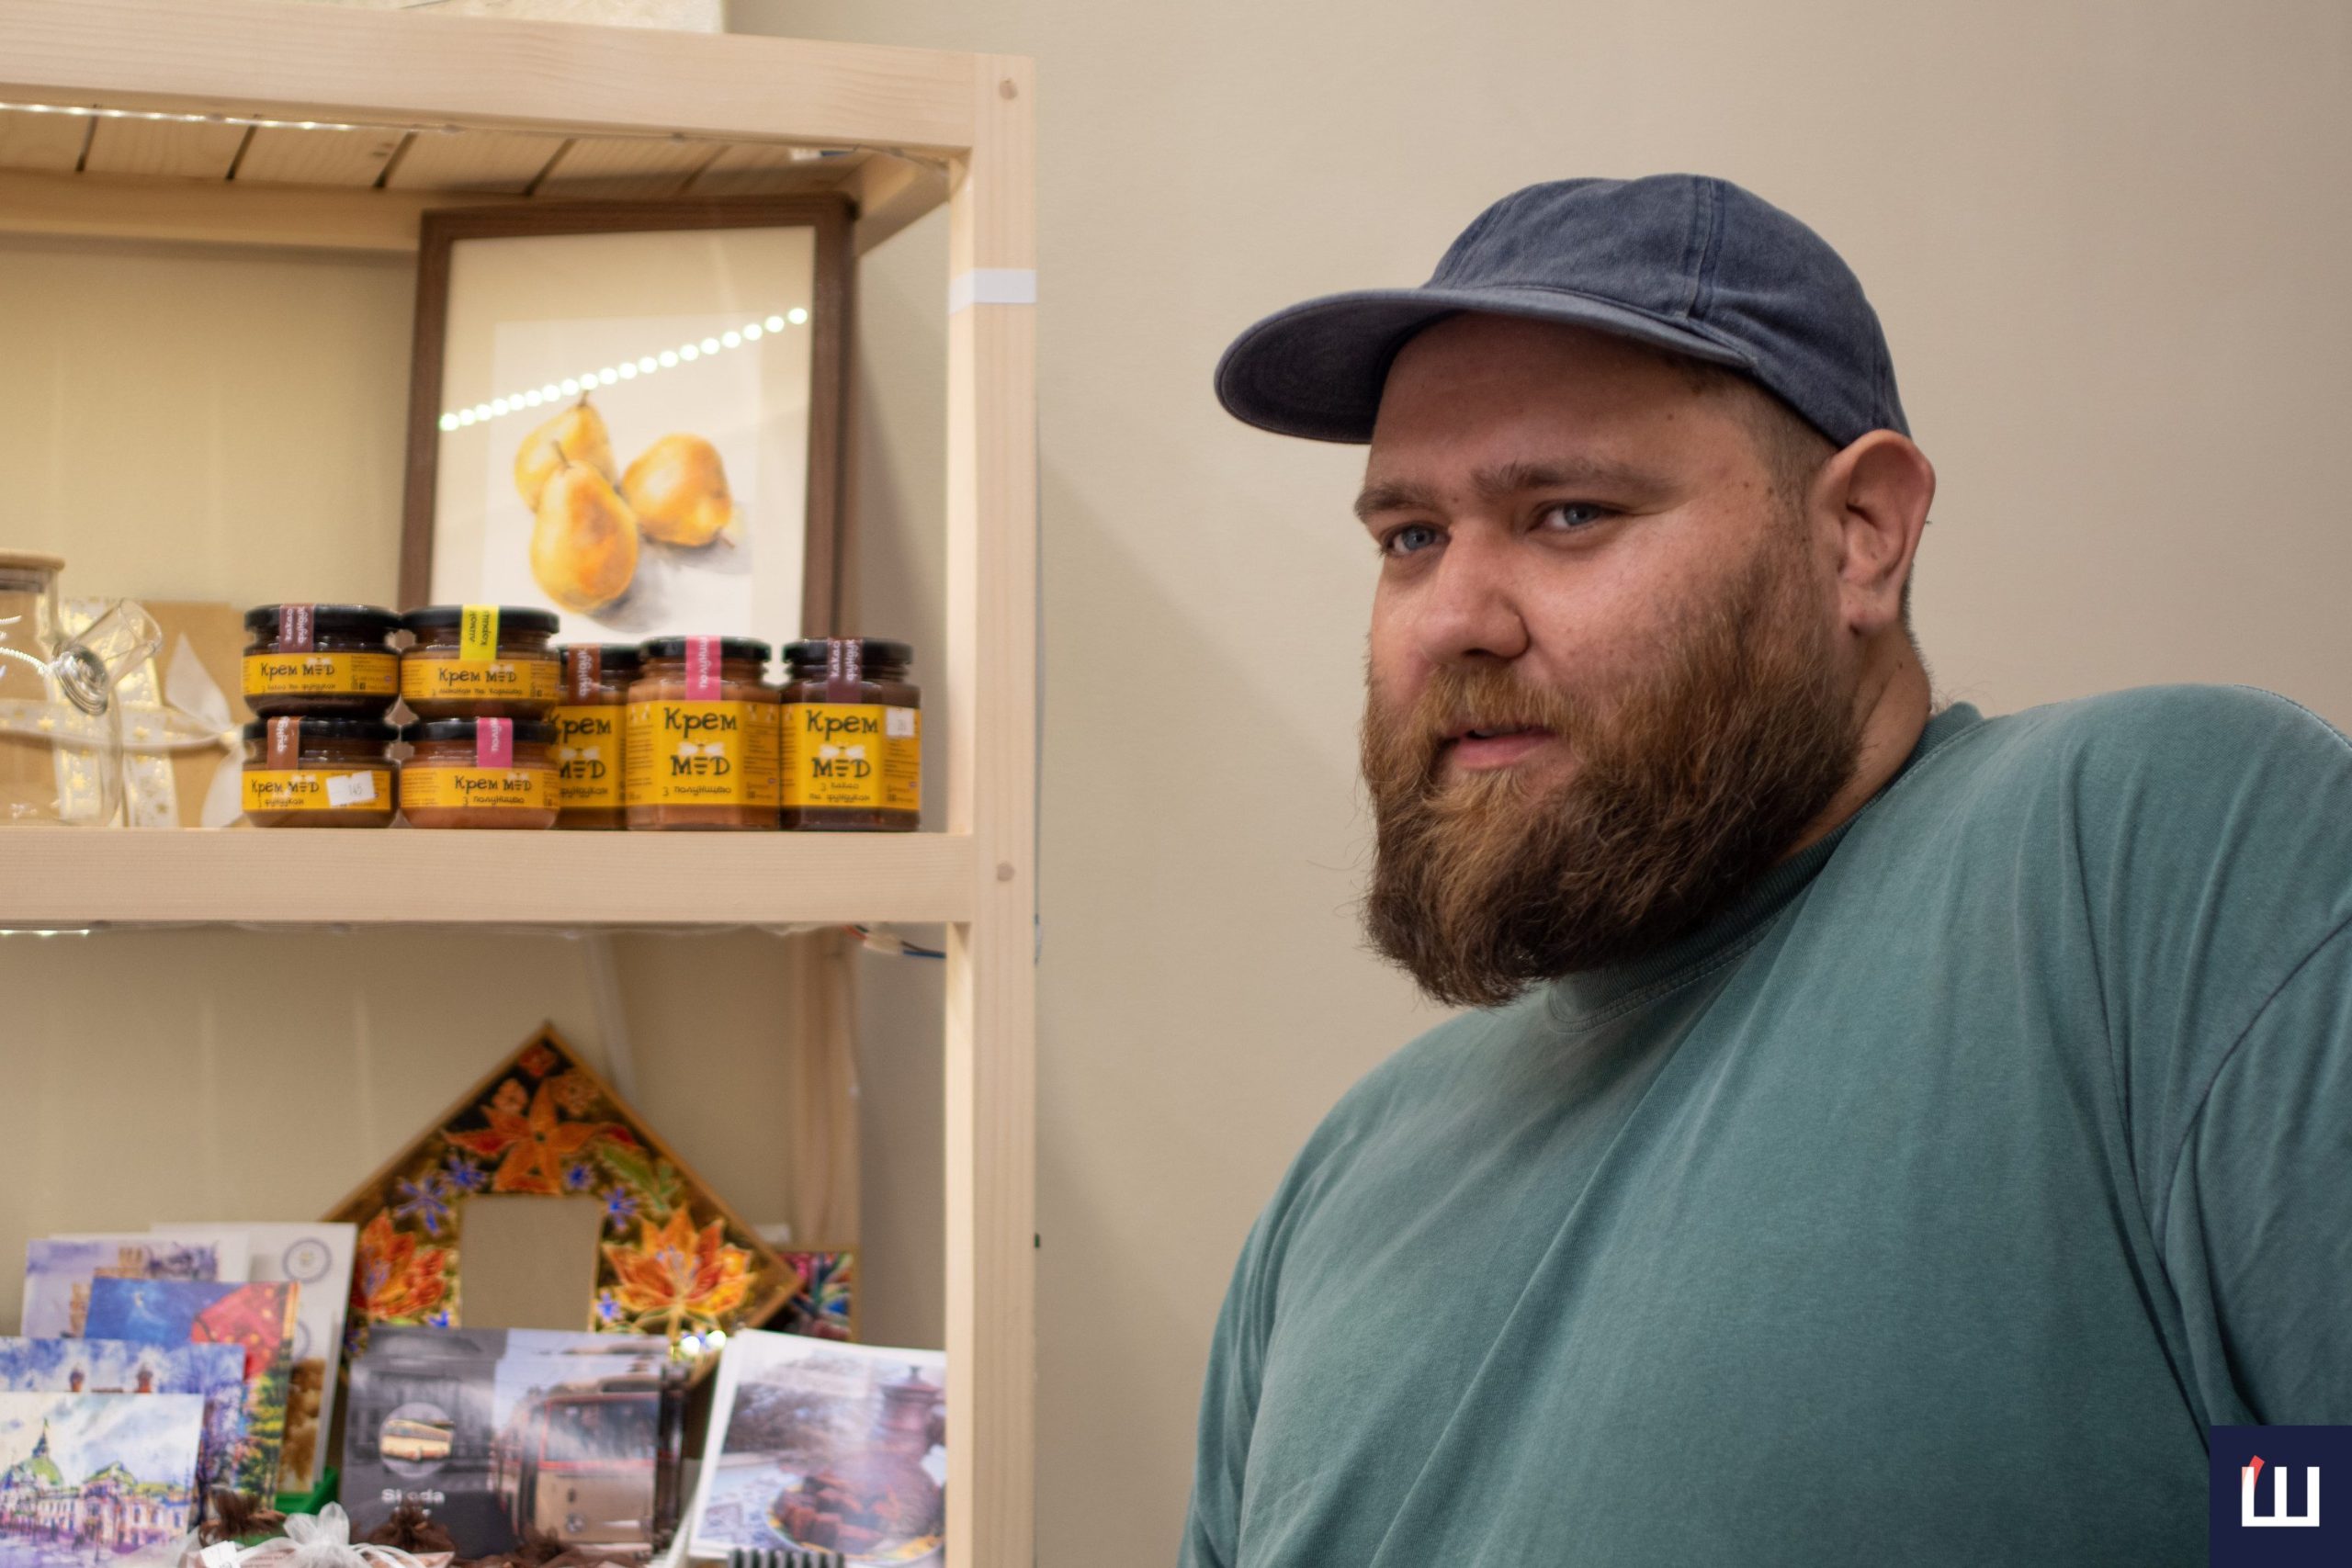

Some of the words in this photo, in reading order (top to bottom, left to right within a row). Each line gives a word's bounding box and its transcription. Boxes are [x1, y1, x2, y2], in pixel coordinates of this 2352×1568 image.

[261, 663, 298, 681] Крем
[439, 668, 481, 686] Крем
[663, 706, 738, 739] Крем
[806, 709, 878, 741] Крем
[251, 779, 283, 797] Крем
[455, 775, 498, 794] Крем
